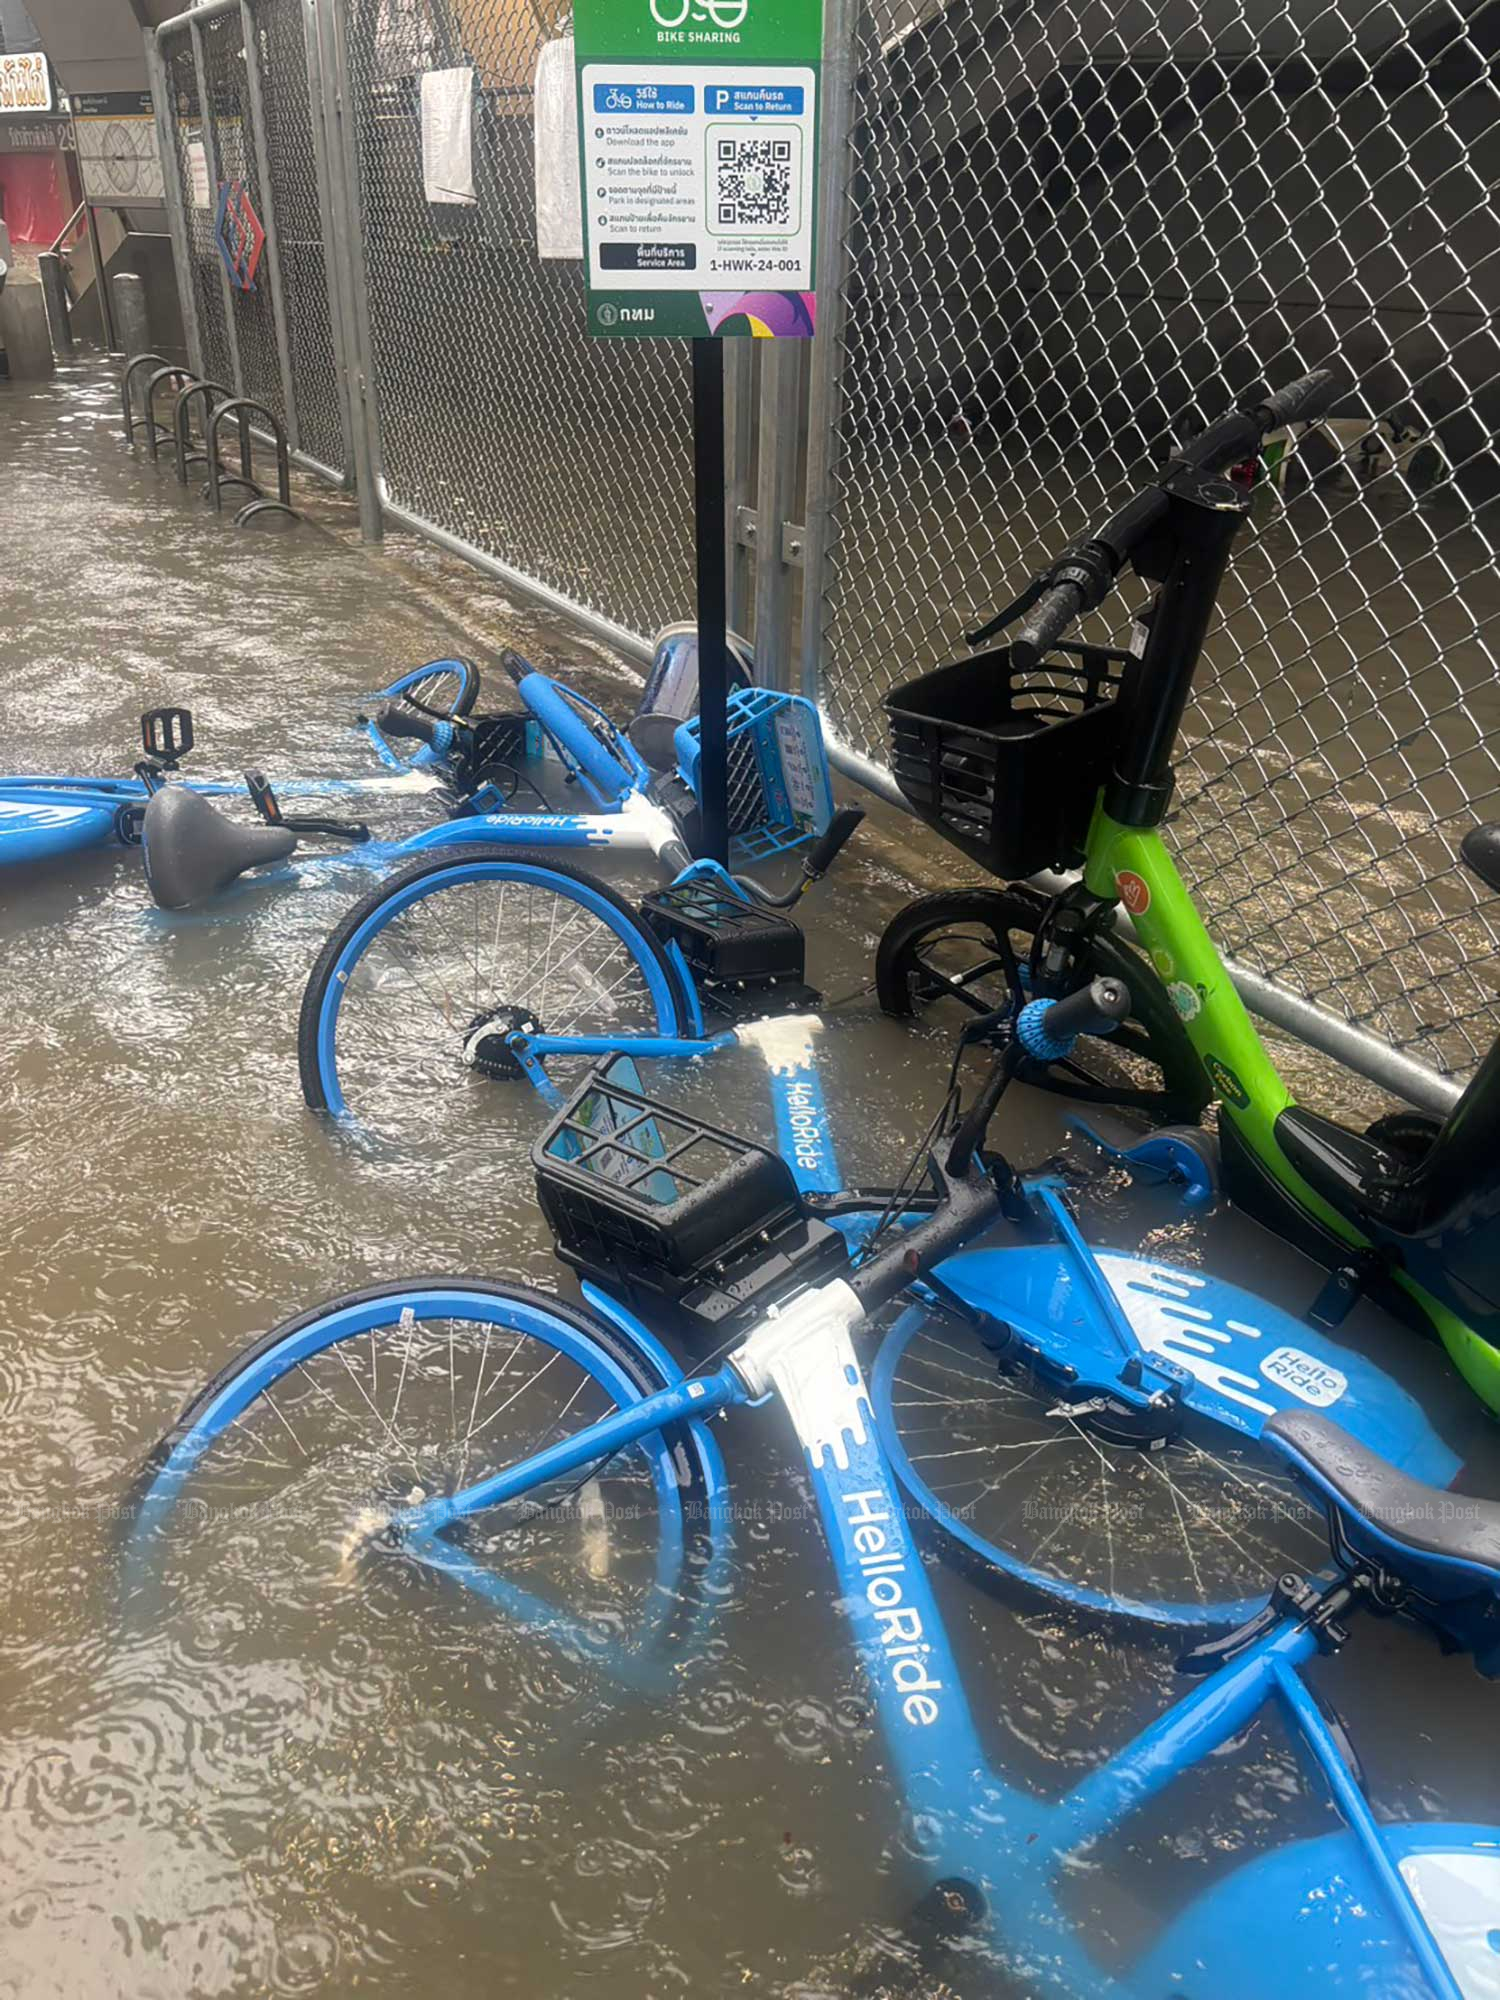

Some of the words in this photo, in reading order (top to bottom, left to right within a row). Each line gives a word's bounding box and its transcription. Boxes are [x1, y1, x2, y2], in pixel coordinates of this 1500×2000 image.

[657, 31, 685, 42] BIKE
[688, 32, 740, 43] SHARING
[636, 101, 655, 109] How
[656, 101, 664, 109] to
[666, 101, 685, 110] Ride
[716, 90, 729, 110] P
[734, 102, 754, 110] Scan
[755, 102, 763, 110] to
[765, 102, 792, 111] Return
[607, 137, 645, 146] Download
[647, 138, 659, 146] the
[661, 139, 675, 148] app
[608, 168, 626, 176] Scan
[628, 168, 640, 176] the
[642, 168, 658, 176] bike
[660, 168, 668, 176] to
[670, 168, 695, 177] unlock
[609, 197, 625, 205] Park
[627, 197, 633, 205] in
[635, 197, 674, 206] designated
[610, 225, 628, 233] Scan
[637, 259, 666, 267] Service
[667, 259, 686, 267] Area
[710, 260, 802, 271] 1-HWK-24-001
[620, 308, 655, 321] กทม
[486, 815, 569, 826] HelloRide
[784, 1082, 825, 1170] HelloRide
[1278, 1351, 1338, 1390] Hello
[1267, 1361, 1321, 1397] Ride
[841, 1489, 943, 1726] HelloRide
